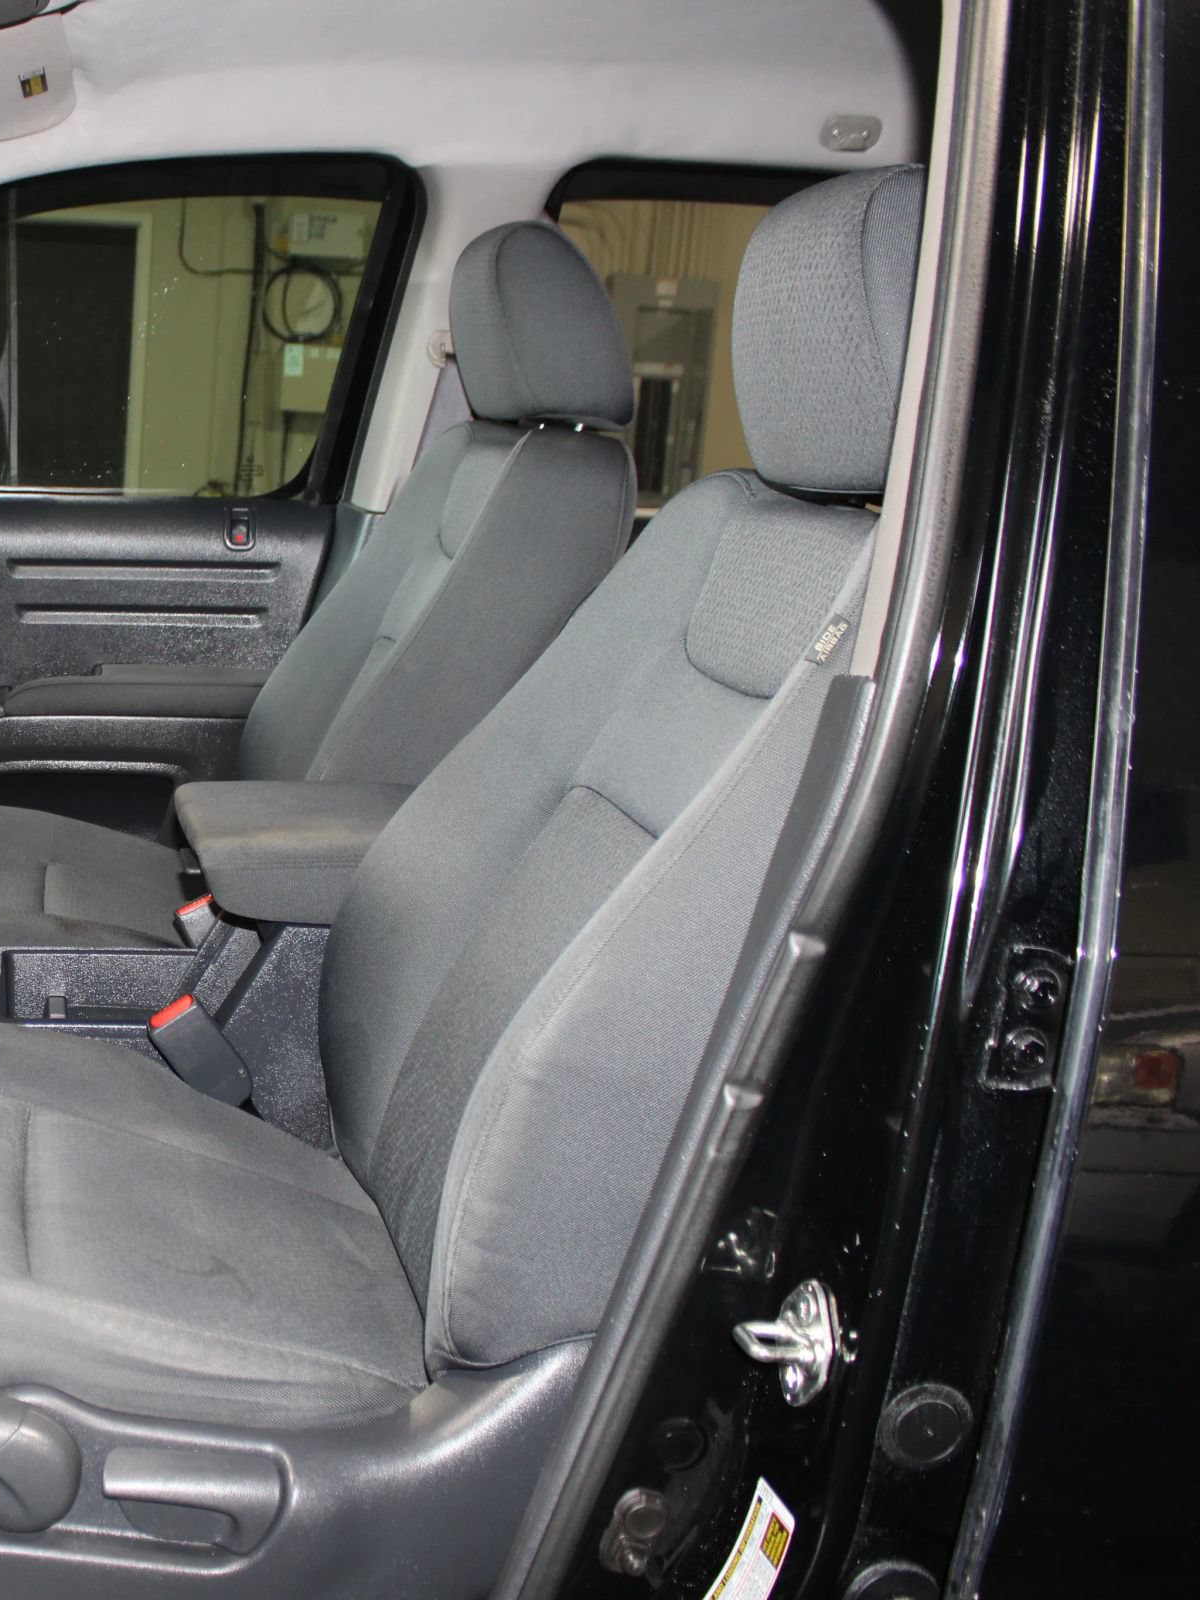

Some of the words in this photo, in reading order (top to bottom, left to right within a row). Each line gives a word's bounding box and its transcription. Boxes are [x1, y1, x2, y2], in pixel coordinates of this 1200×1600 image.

[814, 624, 837, 652] SIDE
[820, 623, 848, 662] AIRBAG
[739, 1501, 762, 1553] INFORMATION
